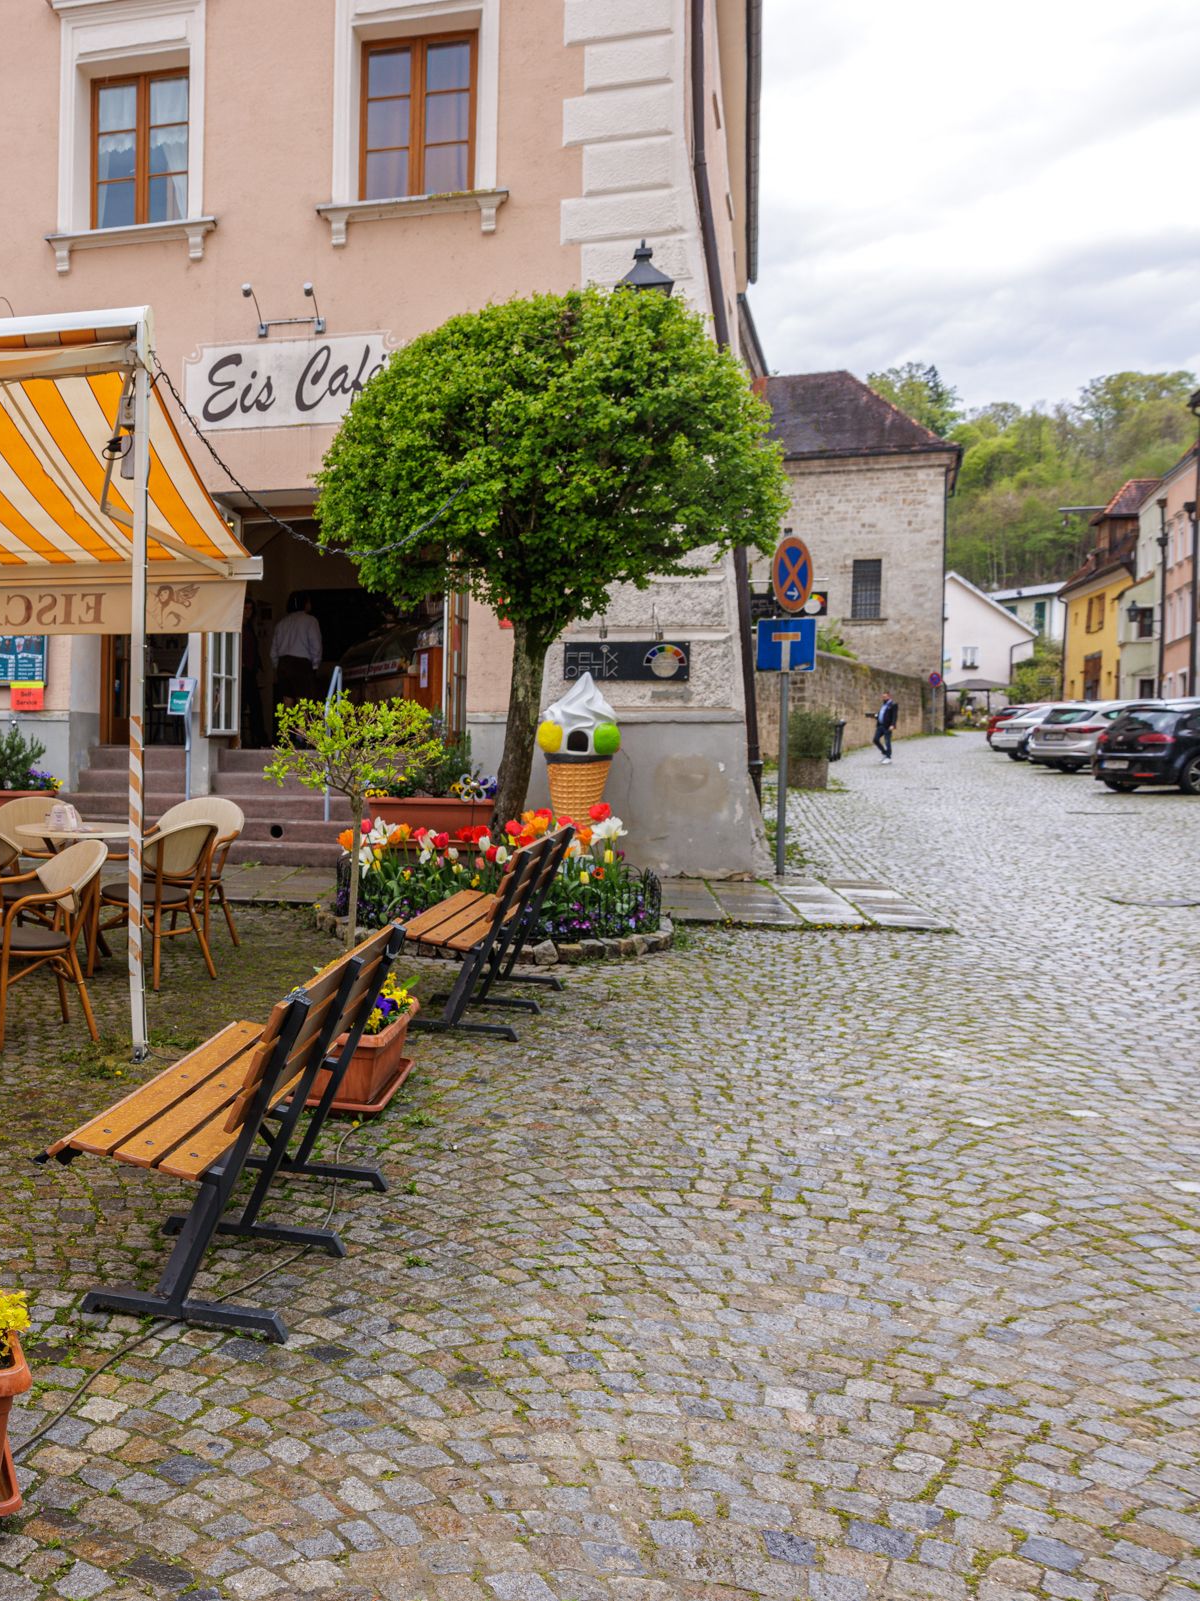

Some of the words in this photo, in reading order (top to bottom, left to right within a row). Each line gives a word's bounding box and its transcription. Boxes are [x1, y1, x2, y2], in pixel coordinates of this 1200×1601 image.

[202, 353, 276, 423] Eis
[565, 649, 619, 664] FELIX
[565, 665, 619, 678] OPTIK
